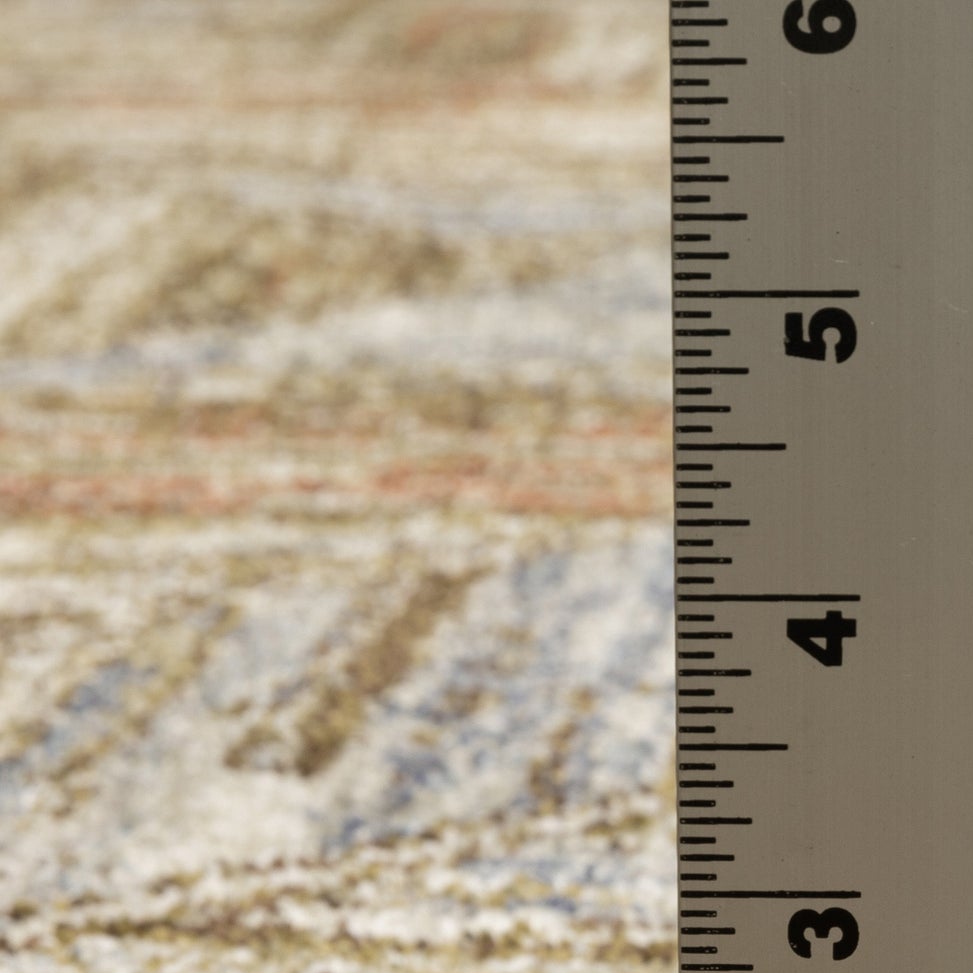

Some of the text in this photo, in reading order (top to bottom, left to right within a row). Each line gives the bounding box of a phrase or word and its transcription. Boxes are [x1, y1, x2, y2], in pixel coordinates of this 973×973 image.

[782, 0, 858, 55] 6
[783, 307, 858, 364] 5
[786, 610, 857, 668] 4
[787, 906, 860, 961] 3
